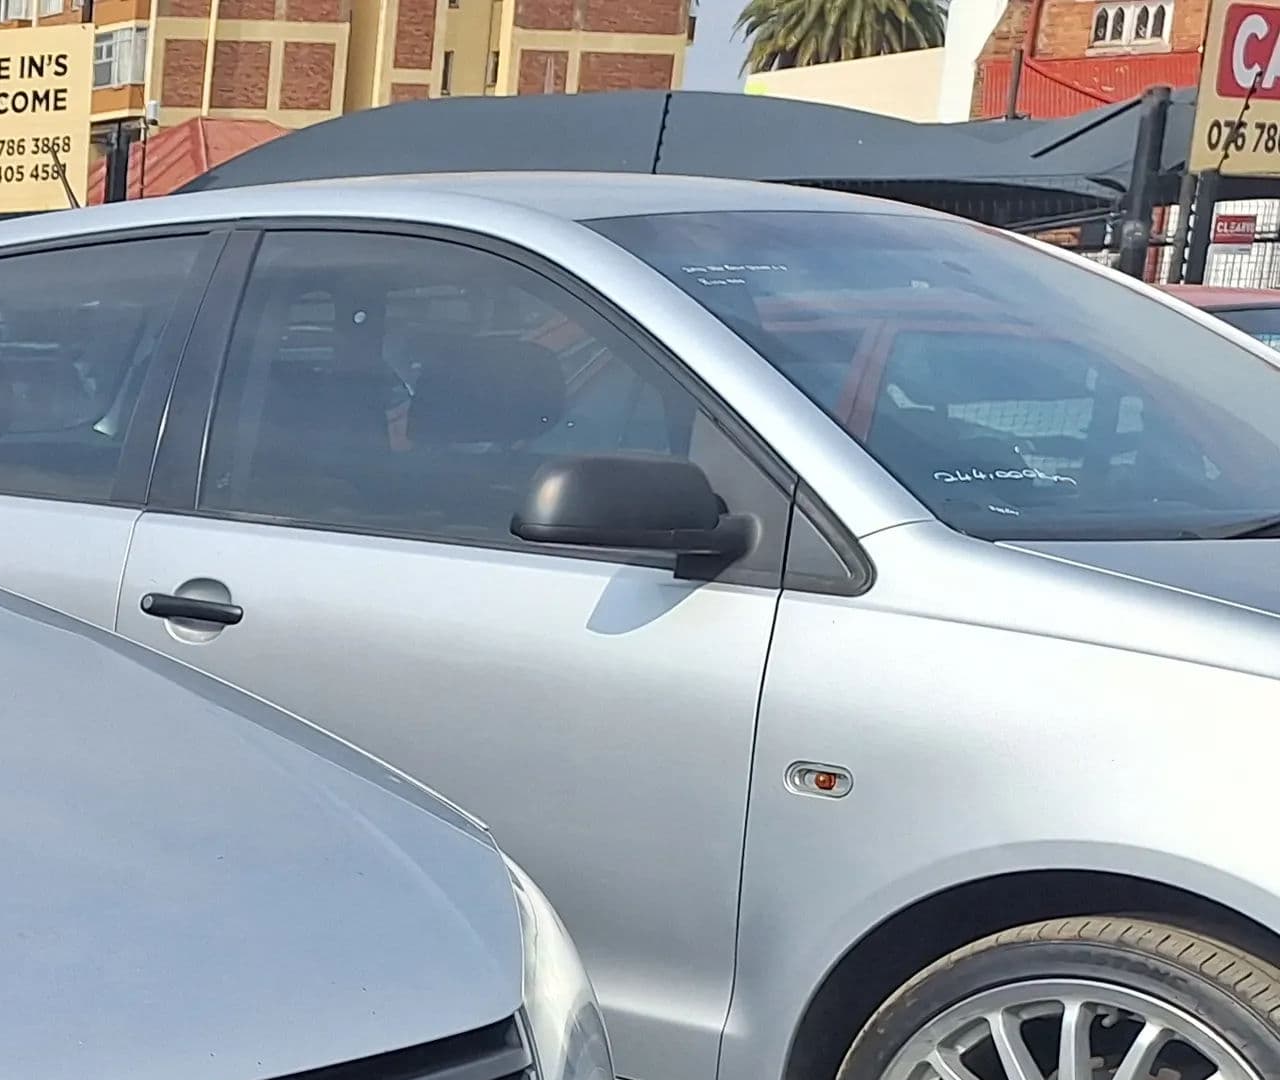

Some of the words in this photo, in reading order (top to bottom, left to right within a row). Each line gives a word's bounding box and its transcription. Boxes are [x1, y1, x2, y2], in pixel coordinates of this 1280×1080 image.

[19, 54, 68, 79] IN'S
[31, 135, 71, 155] 3868
[1207, 119, 1247, 152] 076
[1252, 122, 1280, 153] 78
[30, 163, 67, 182] 4581
